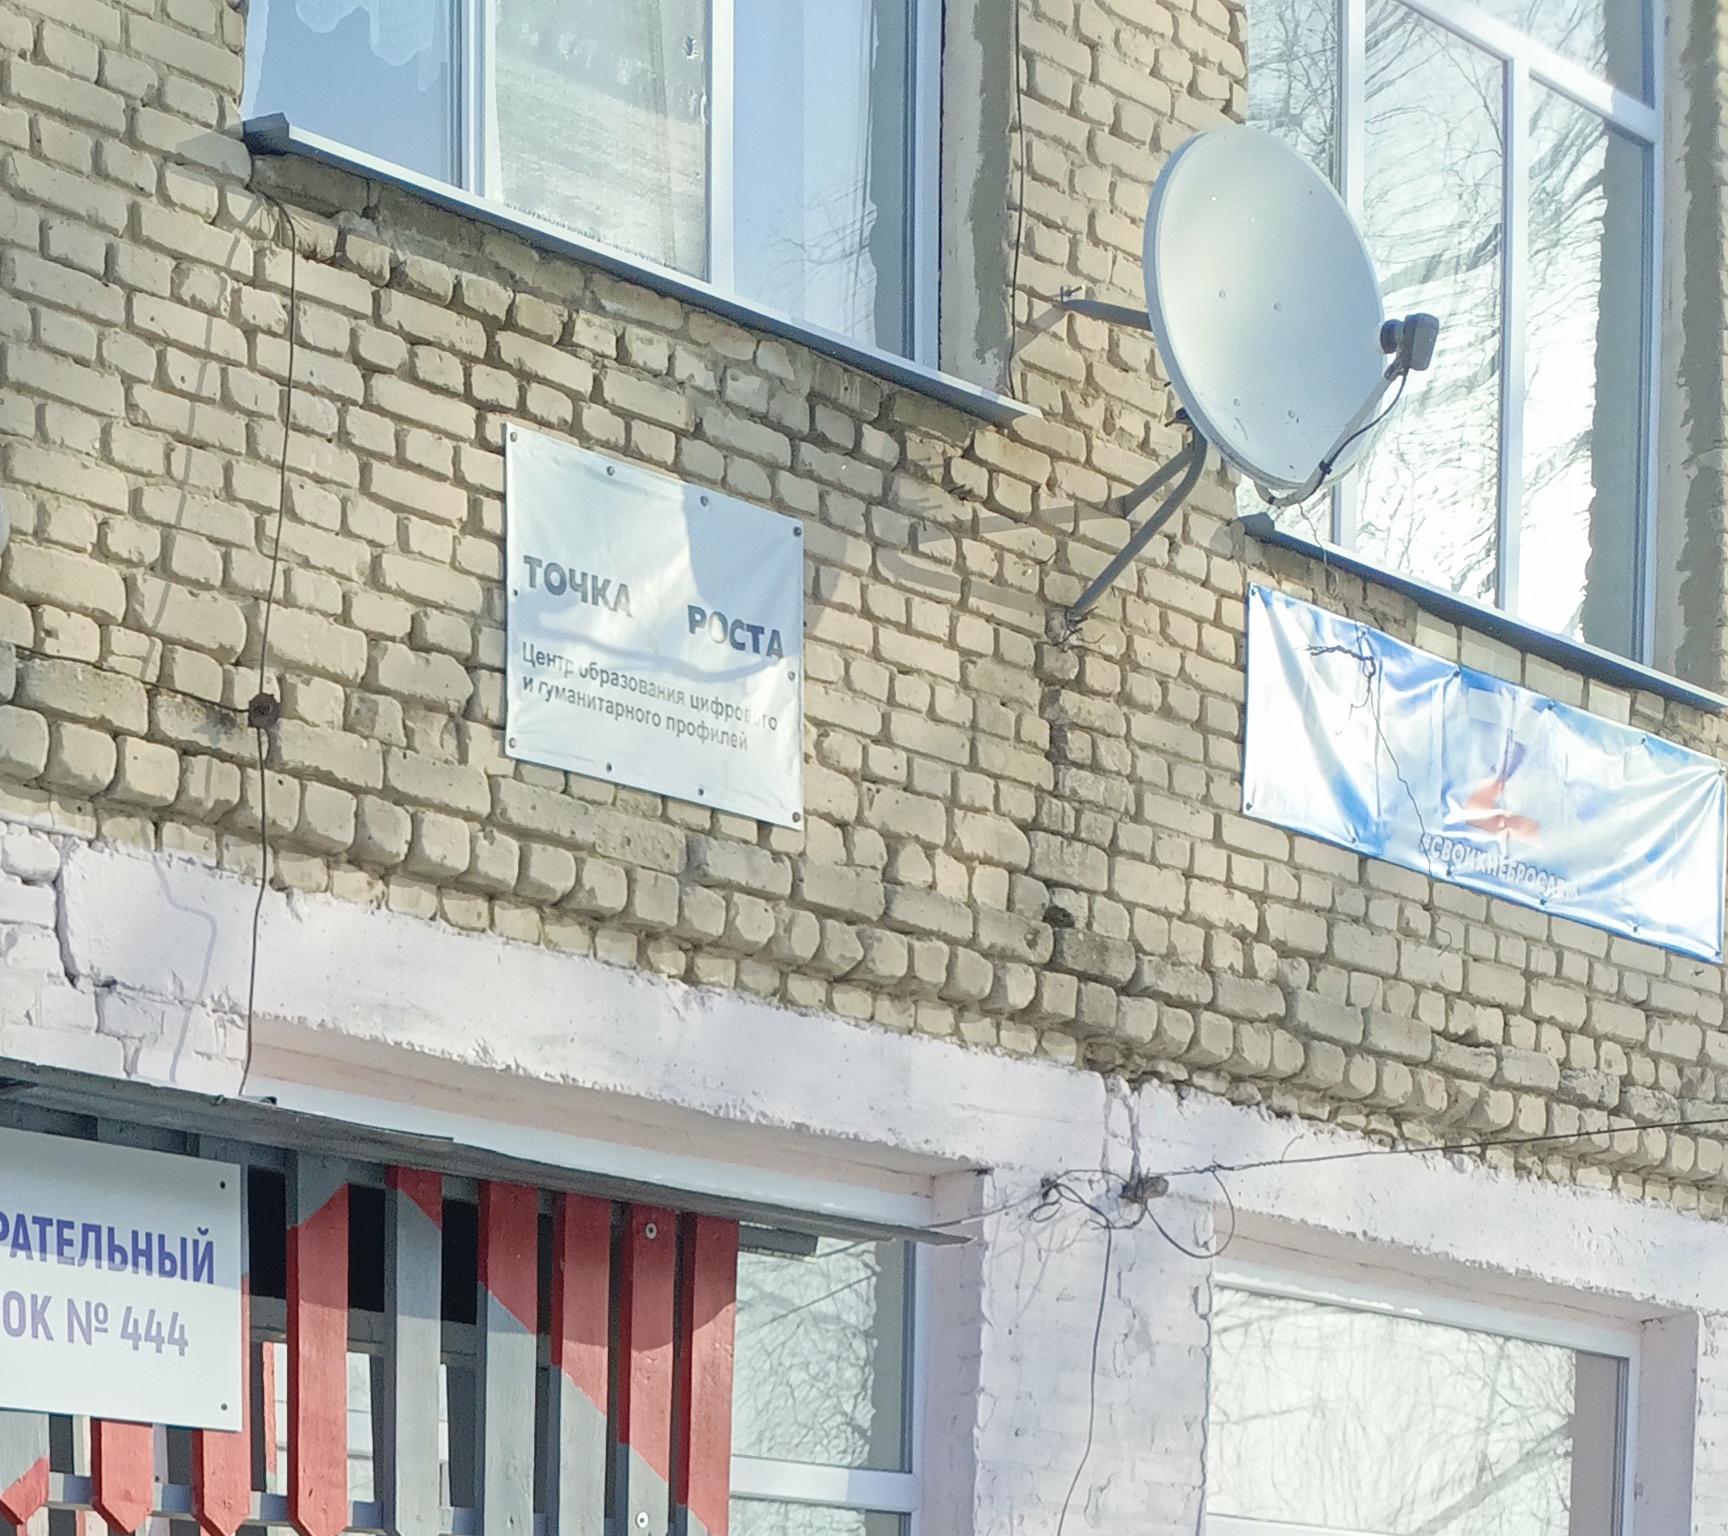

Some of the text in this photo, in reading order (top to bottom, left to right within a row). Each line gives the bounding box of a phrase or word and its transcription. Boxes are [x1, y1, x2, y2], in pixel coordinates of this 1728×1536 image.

[522, 554, 784, 661] ТОЧКА РОСТА
[522, 641, 574, 679] Центр
[579, 661, 685, 706] образования
[522, 675, 749, 751] и гуманитарного профилей
[67, 1298, 109, 1346] №
[120, 1306, 190, 1357] 444
